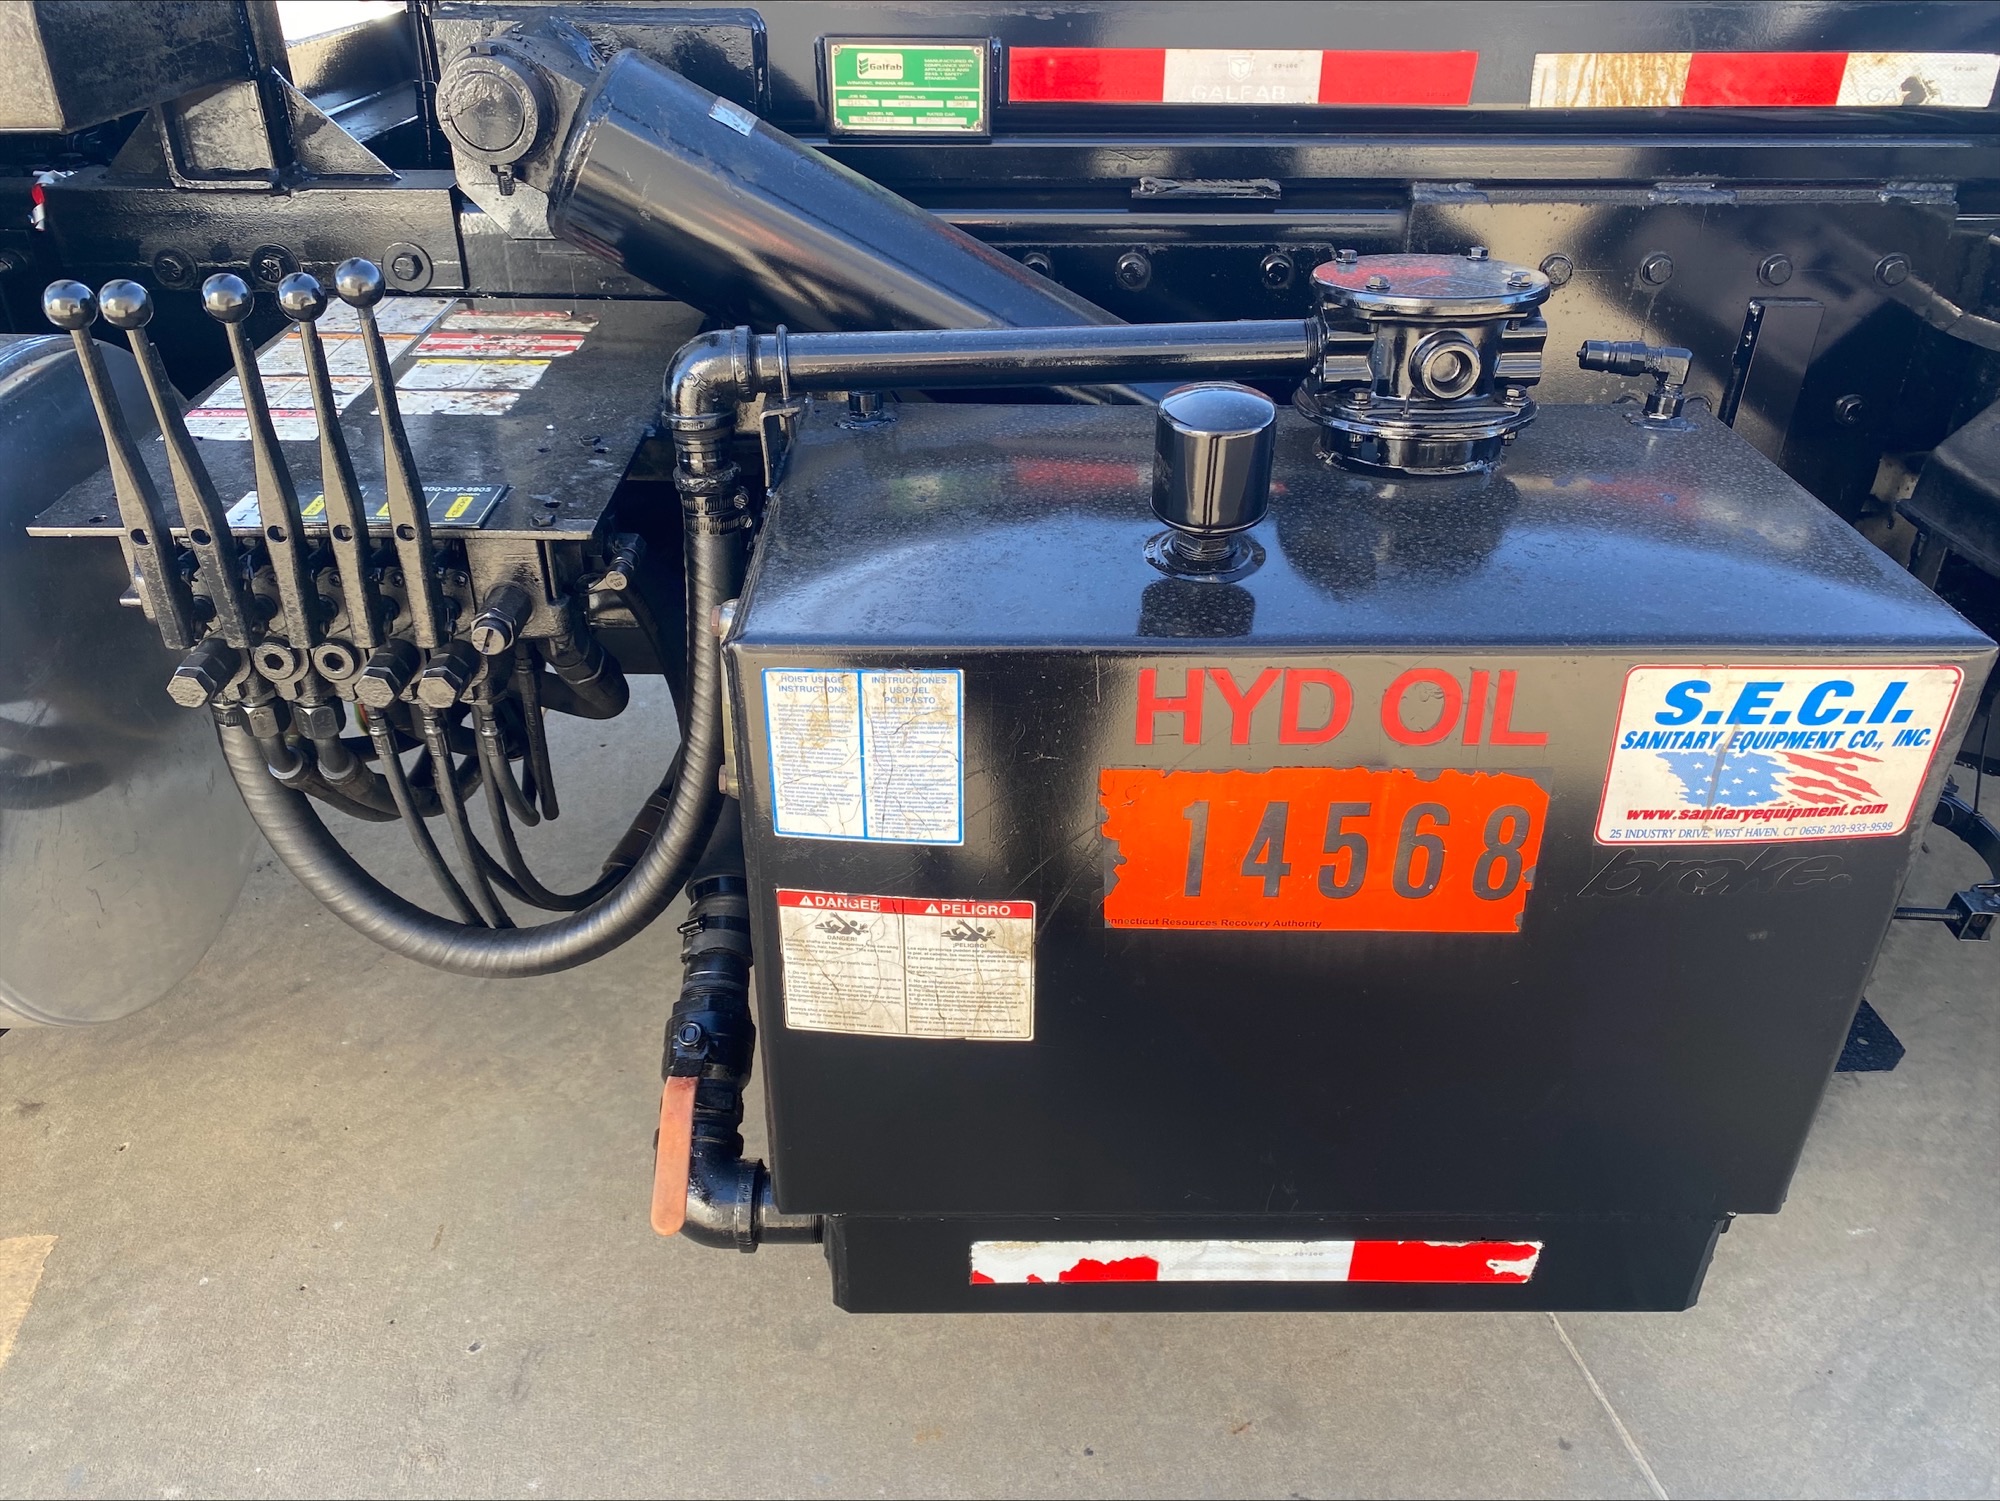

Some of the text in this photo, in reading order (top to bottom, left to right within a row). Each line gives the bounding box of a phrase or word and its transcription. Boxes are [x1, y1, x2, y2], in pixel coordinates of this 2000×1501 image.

[869, 62, 902, 70] Galfab
[1190, 84, 1286, 100] GALFAB
[781, 675, 844, 684] HOIST USAGE
[871, 676, 948, 685] INSTRUCCIONES
[778, 685, 847, 694] INSTRUCTONS
[889, 686, 909, 694] USO
[884, 696, 936, 704] POLIPASTO
[1654, 680, 1914, 726] S.E.C.I.
[1135, 668, 1549, 746] HYD OIL
[1620, 728, 1932, 753] SANITARY EQUIPMENT CO., INC.
[1626, 802, 1888, 823] www.sanitaryequipment.com
[1609, 828, 1623, 839] 25
[1624, 828, 1677, 839] INDUSTRY
[1712, 827, 1741, 838] WEST
[1783, 826, 1799, 837] CT
[1799, 825, 1826, 836] 06516
[1828, 821, 1893, 834] 203-933-9599
[1182, 801, 1532, 900] 14568
[941, 904, 1011, 915] PELIGRO
[1104, 917, 1322, 928] onnecticut Resources Recovery Authority
